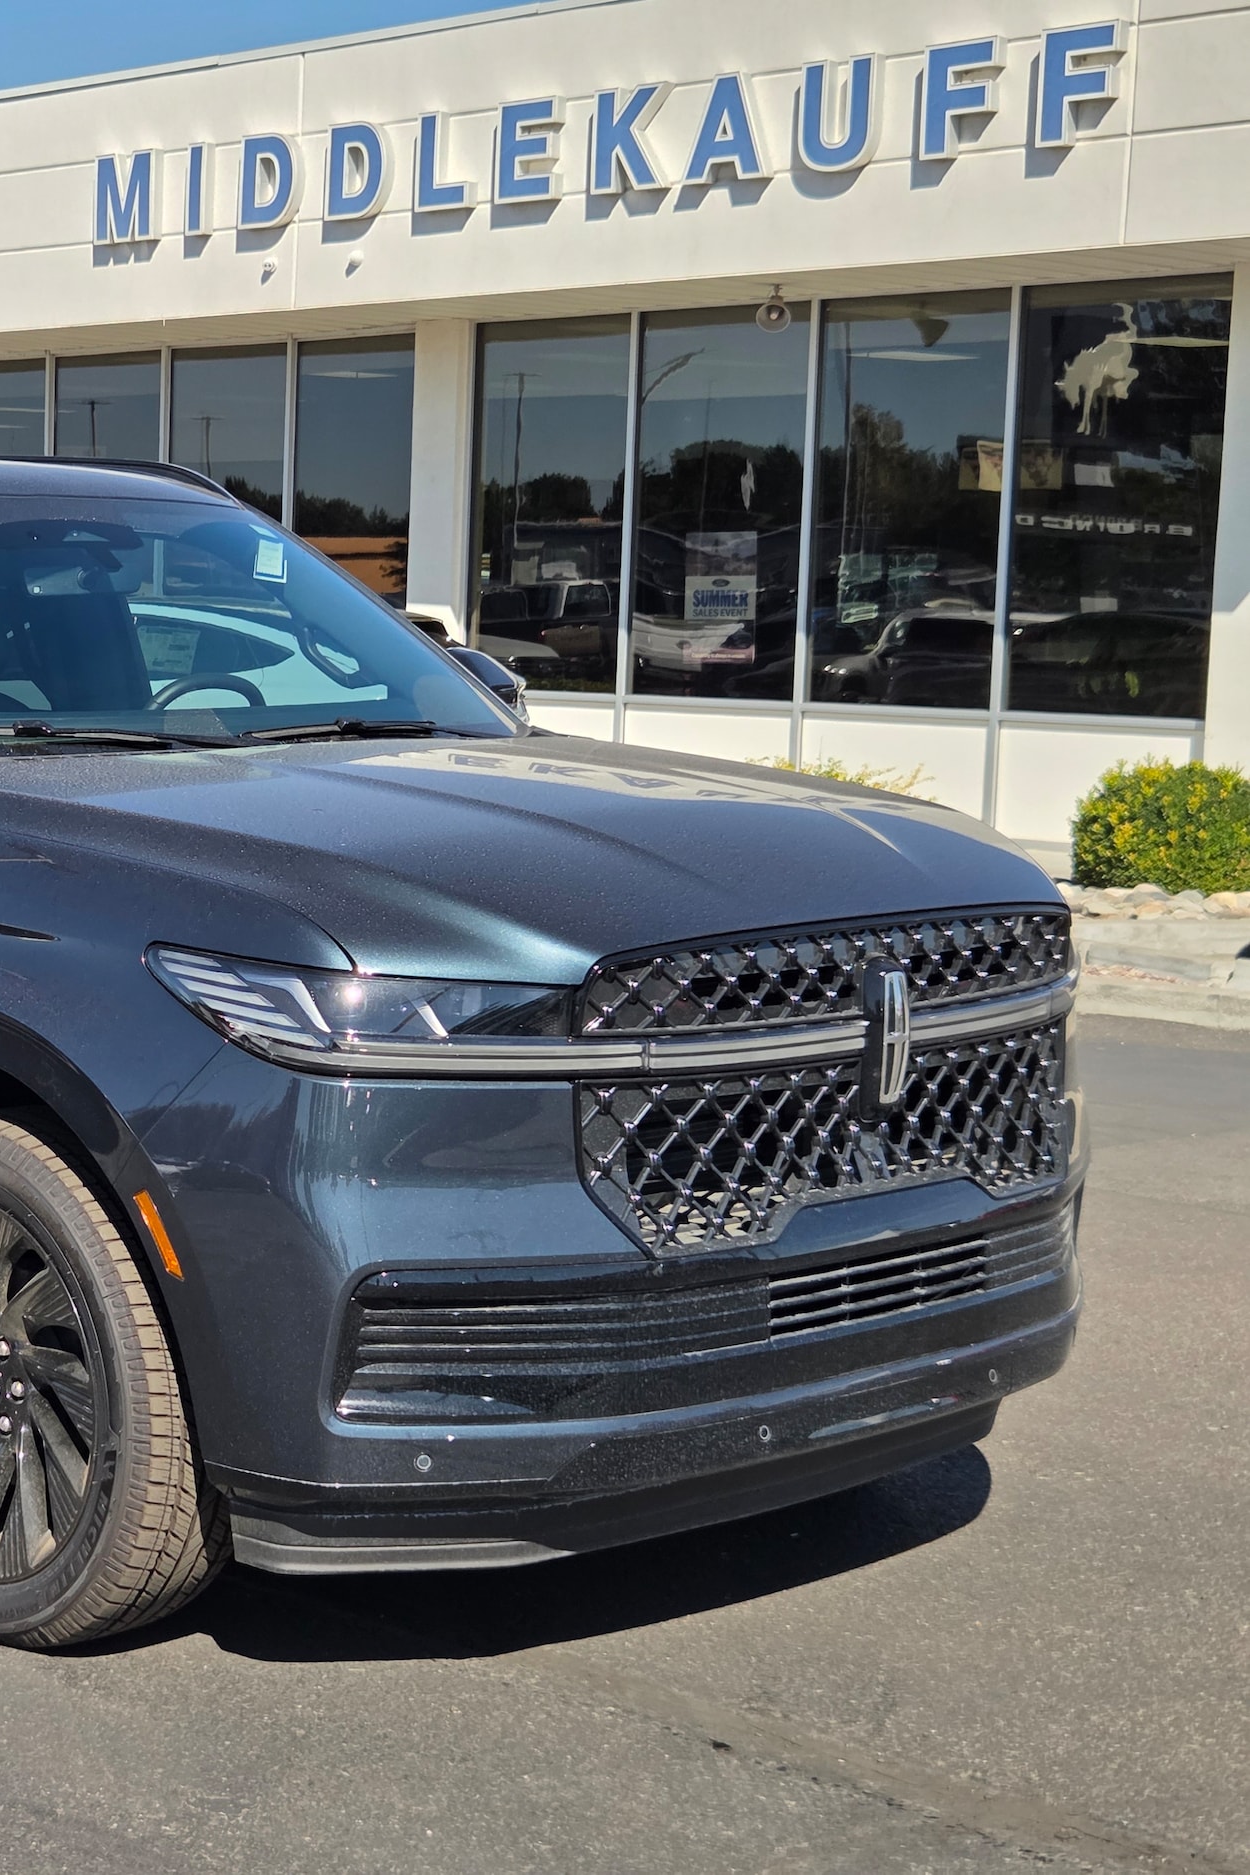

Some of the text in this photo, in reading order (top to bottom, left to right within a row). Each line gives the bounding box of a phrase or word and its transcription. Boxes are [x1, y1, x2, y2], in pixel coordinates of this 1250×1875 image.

[94, 19, 1127, 245] MIDDLEKAUFF
[693, 589, 748, 608] SUMMER
[692, 608, 748, 618] SALES EVENT
